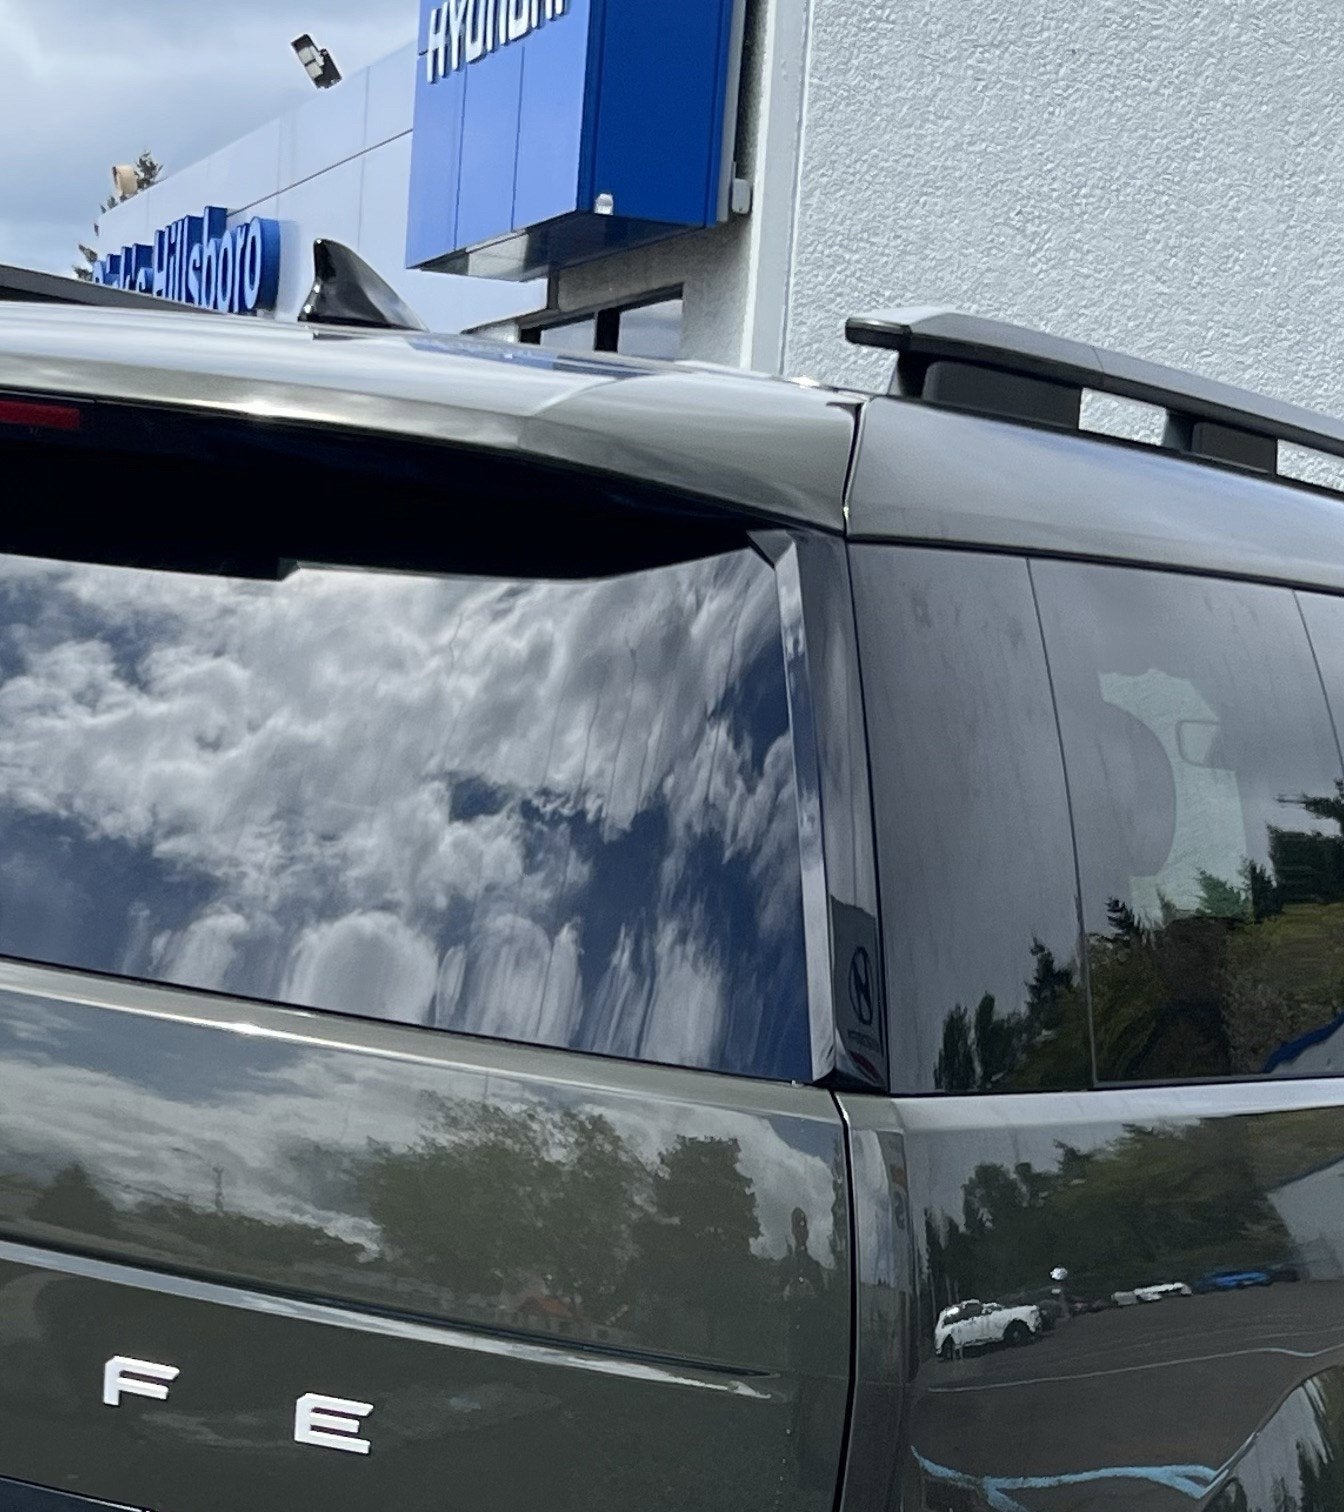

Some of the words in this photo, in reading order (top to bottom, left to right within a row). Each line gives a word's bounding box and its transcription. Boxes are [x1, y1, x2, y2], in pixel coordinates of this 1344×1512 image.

[427, 0, 564, 82] HYUND
[154, 206, 263, 313] Hillsboro
[102, 1355, 375, 1454] FE
